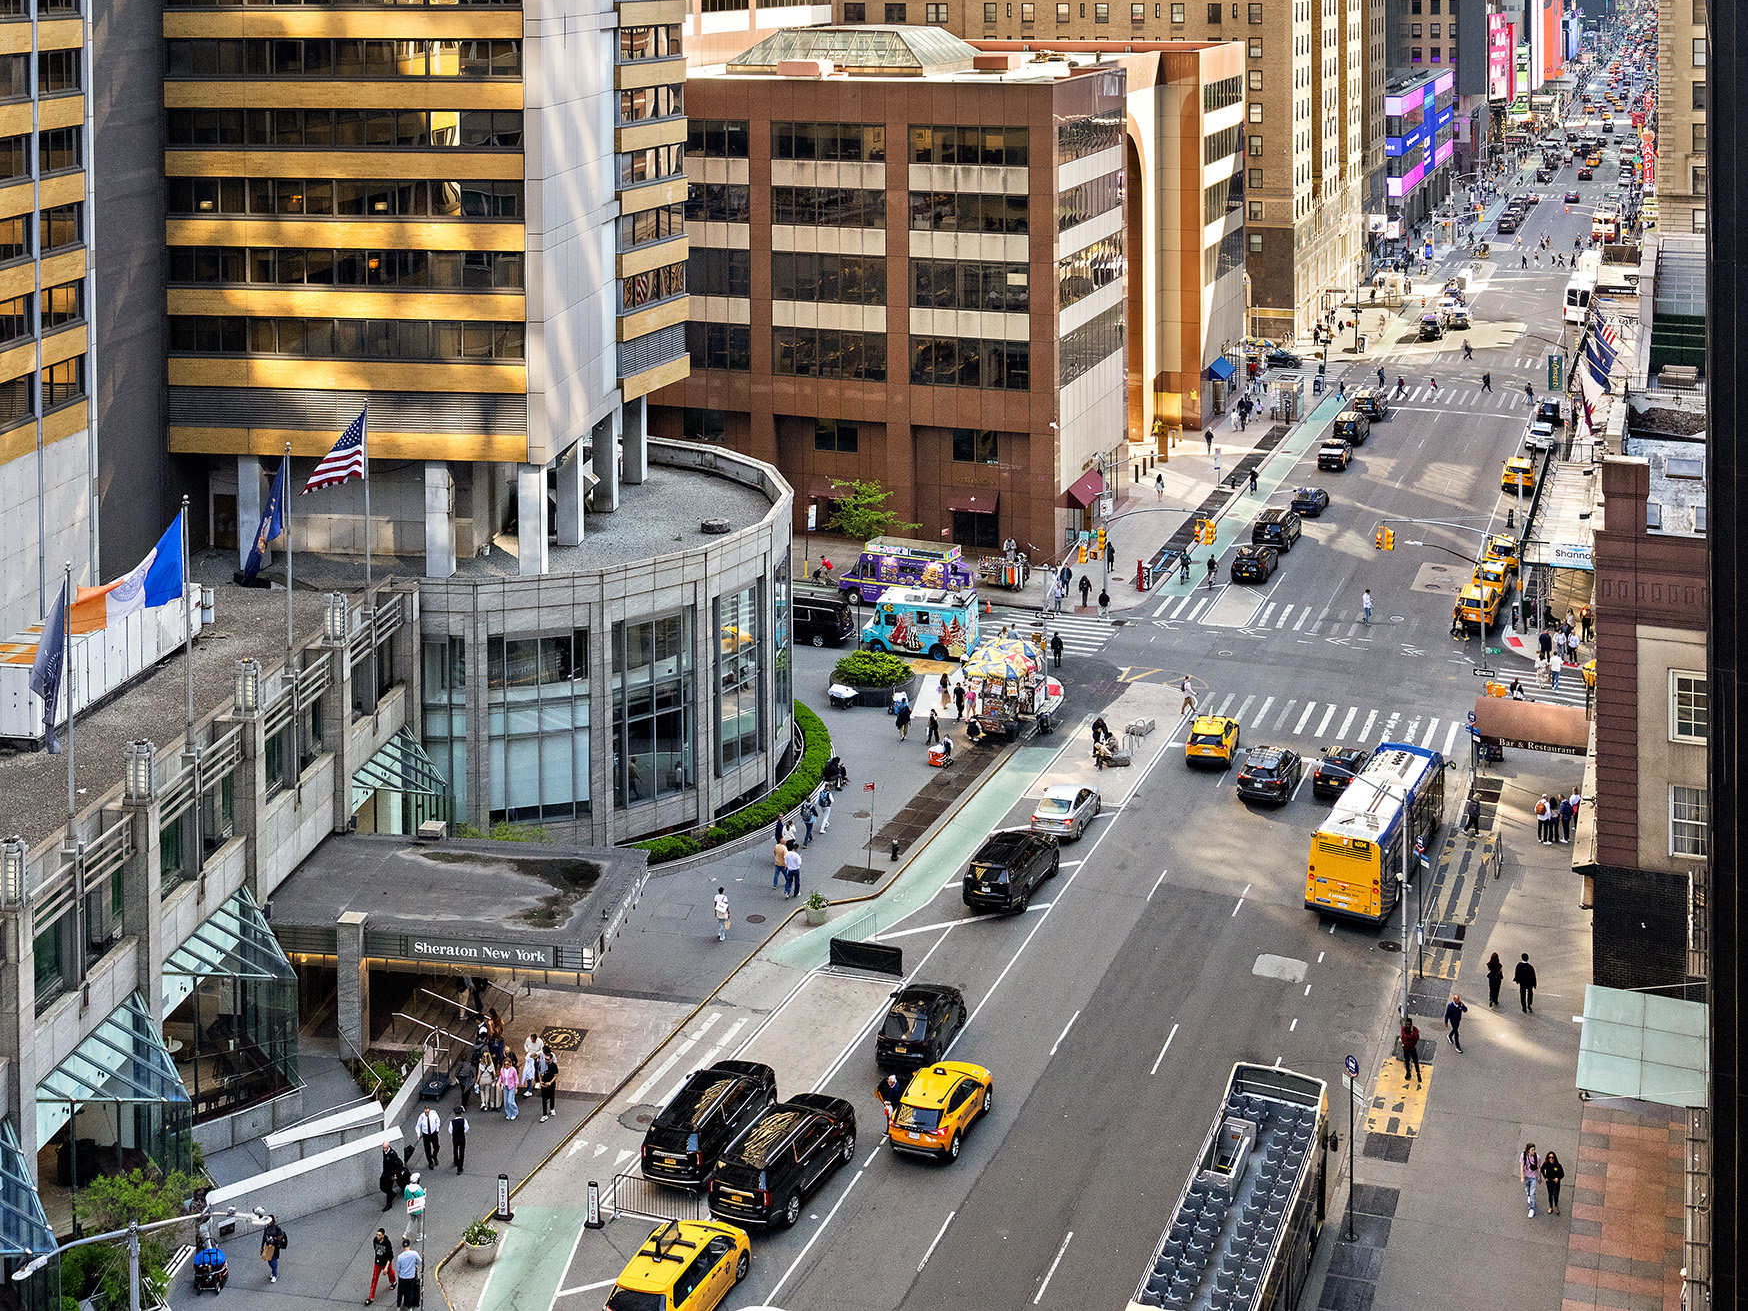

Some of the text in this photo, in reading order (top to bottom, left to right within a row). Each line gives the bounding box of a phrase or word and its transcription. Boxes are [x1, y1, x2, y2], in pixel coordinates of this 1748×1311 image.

[1499, 738, 1576, 755] Bar & Restaurant
[414, 941, 546, 963] Sheraton New York
